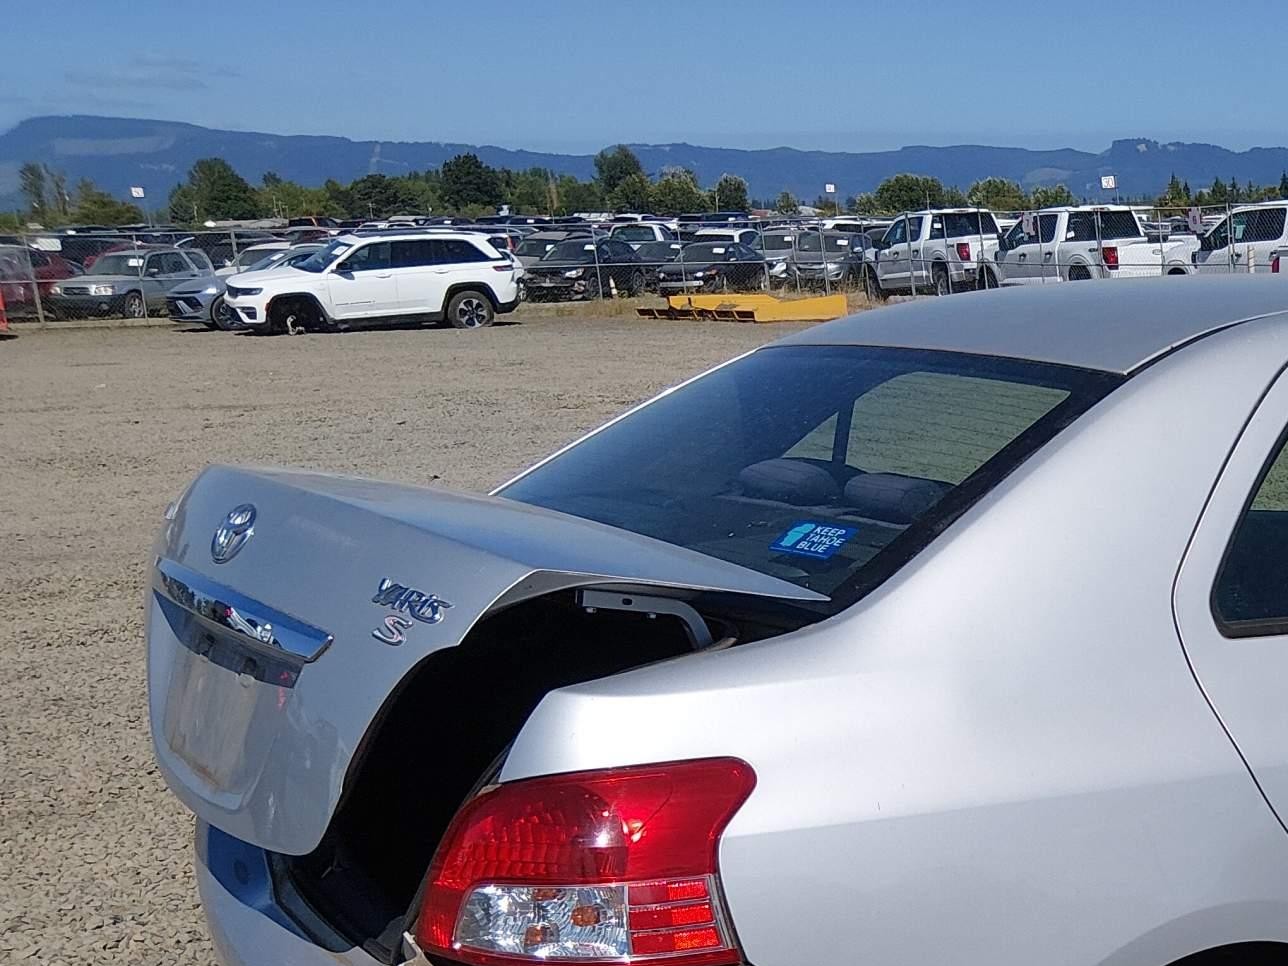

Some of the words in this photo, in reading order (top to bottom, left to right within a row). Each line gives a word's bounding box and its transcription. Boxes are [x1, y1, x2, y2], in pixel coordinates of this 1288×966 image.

[813, 526, 847, 537] KEEP
[806, 533, 847, 547] TAHOE
[796, 541, 829, 553] BLUE
[371, 614, 414, 647] S
